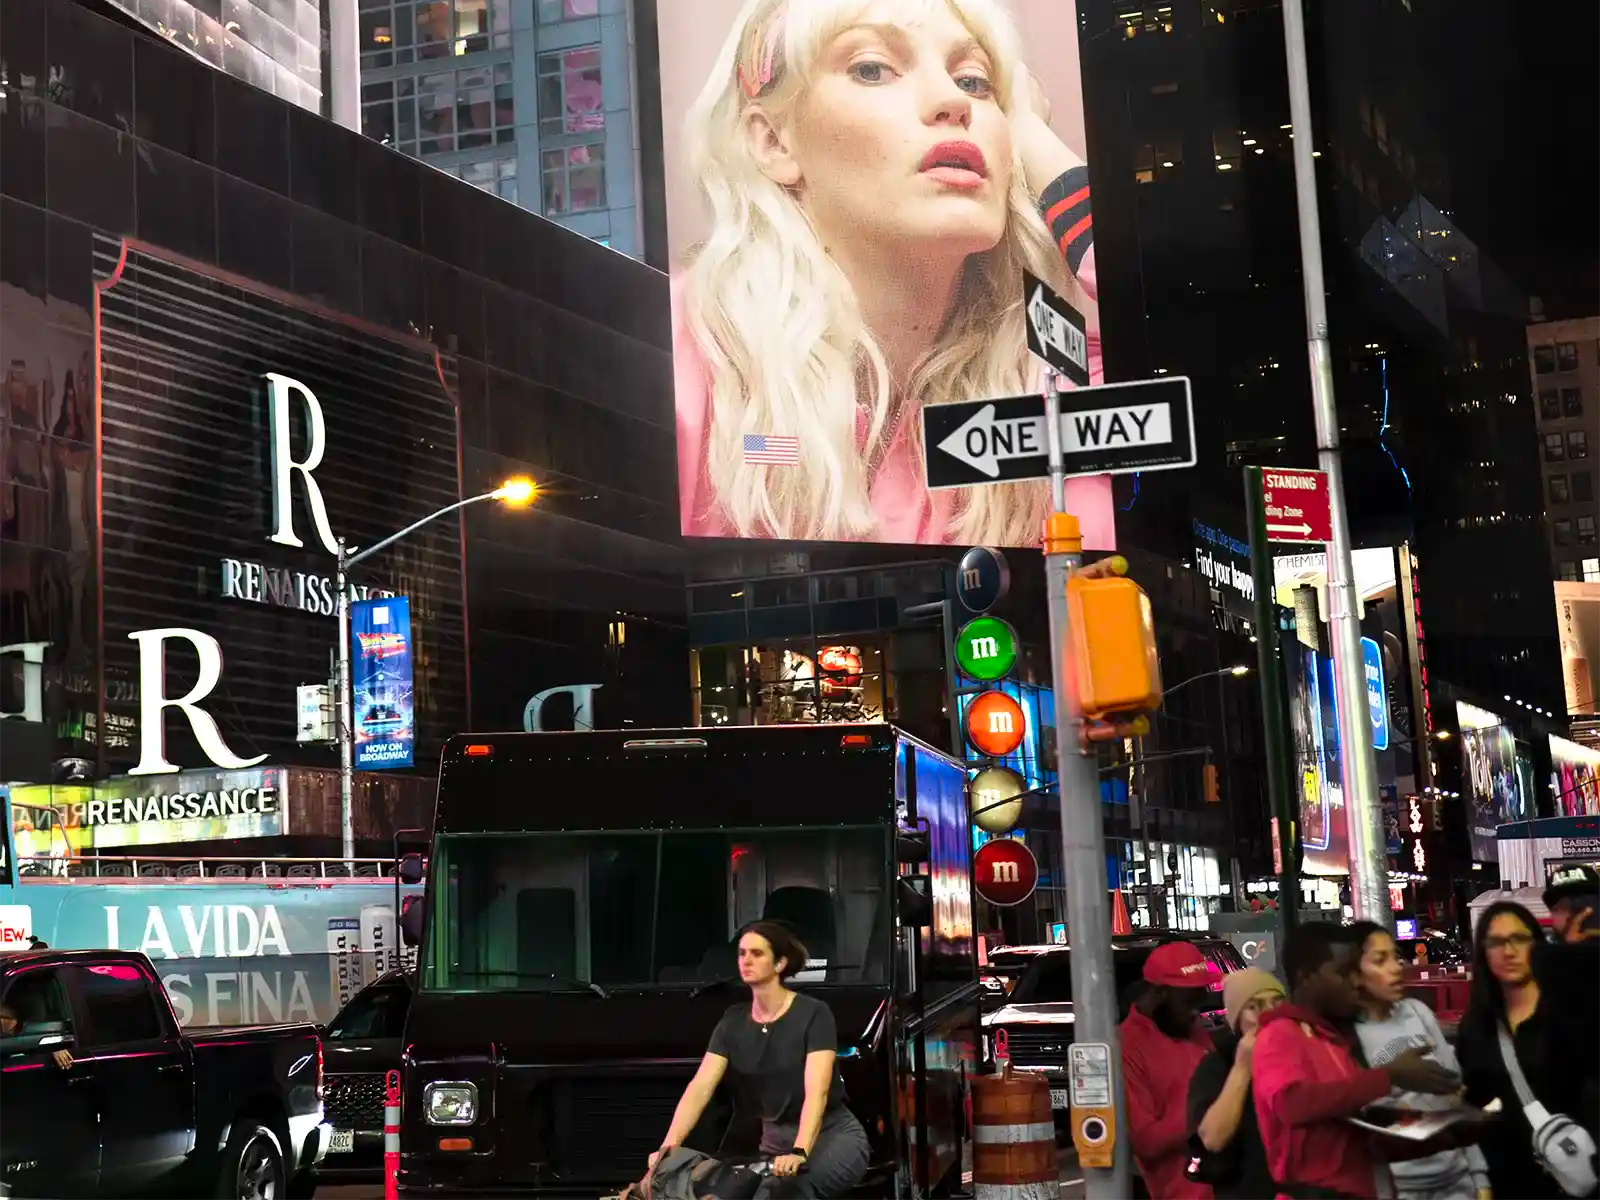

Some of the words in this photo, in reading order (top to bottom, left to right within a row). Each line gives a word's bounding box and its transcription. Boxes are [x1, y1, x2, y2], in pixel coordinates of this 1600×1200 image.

[1034, 302, 1057, 343] ONE
[1062, 321, 1084, 366] WAY
[965, 421, 1039, 458] ONE
[1074, 409, 1153, 447] WAY
[265, 371, 359, 556] R
[1266, 474, 1317, 490] STANDING
[1283, 505, 1304, 518] Zone
[962, 568, 982, 592] m
[1195, 547, 1214, 579] Find
[1214, 560, 1231, 588] your
[1231, 560, 1255, 602] happy
[970, 636, 998, 660] m
[127, 627, 272, 776] R
[988, 711, 1014, 733] m
[359, 750, 409, 762] BROADWAY
[365, 744, 389, 753] NOW
[389, 742, 403, 751] ON
[87, 786, 275, 826] RENAISSANCE
[991, 860, 1020, 883] m
[103, 904, 178, 960] LA
[171, 904, 293, 959] VIDA
[166, 972, 193, 1027] S
[206, 970, 319, 1026] FINA
